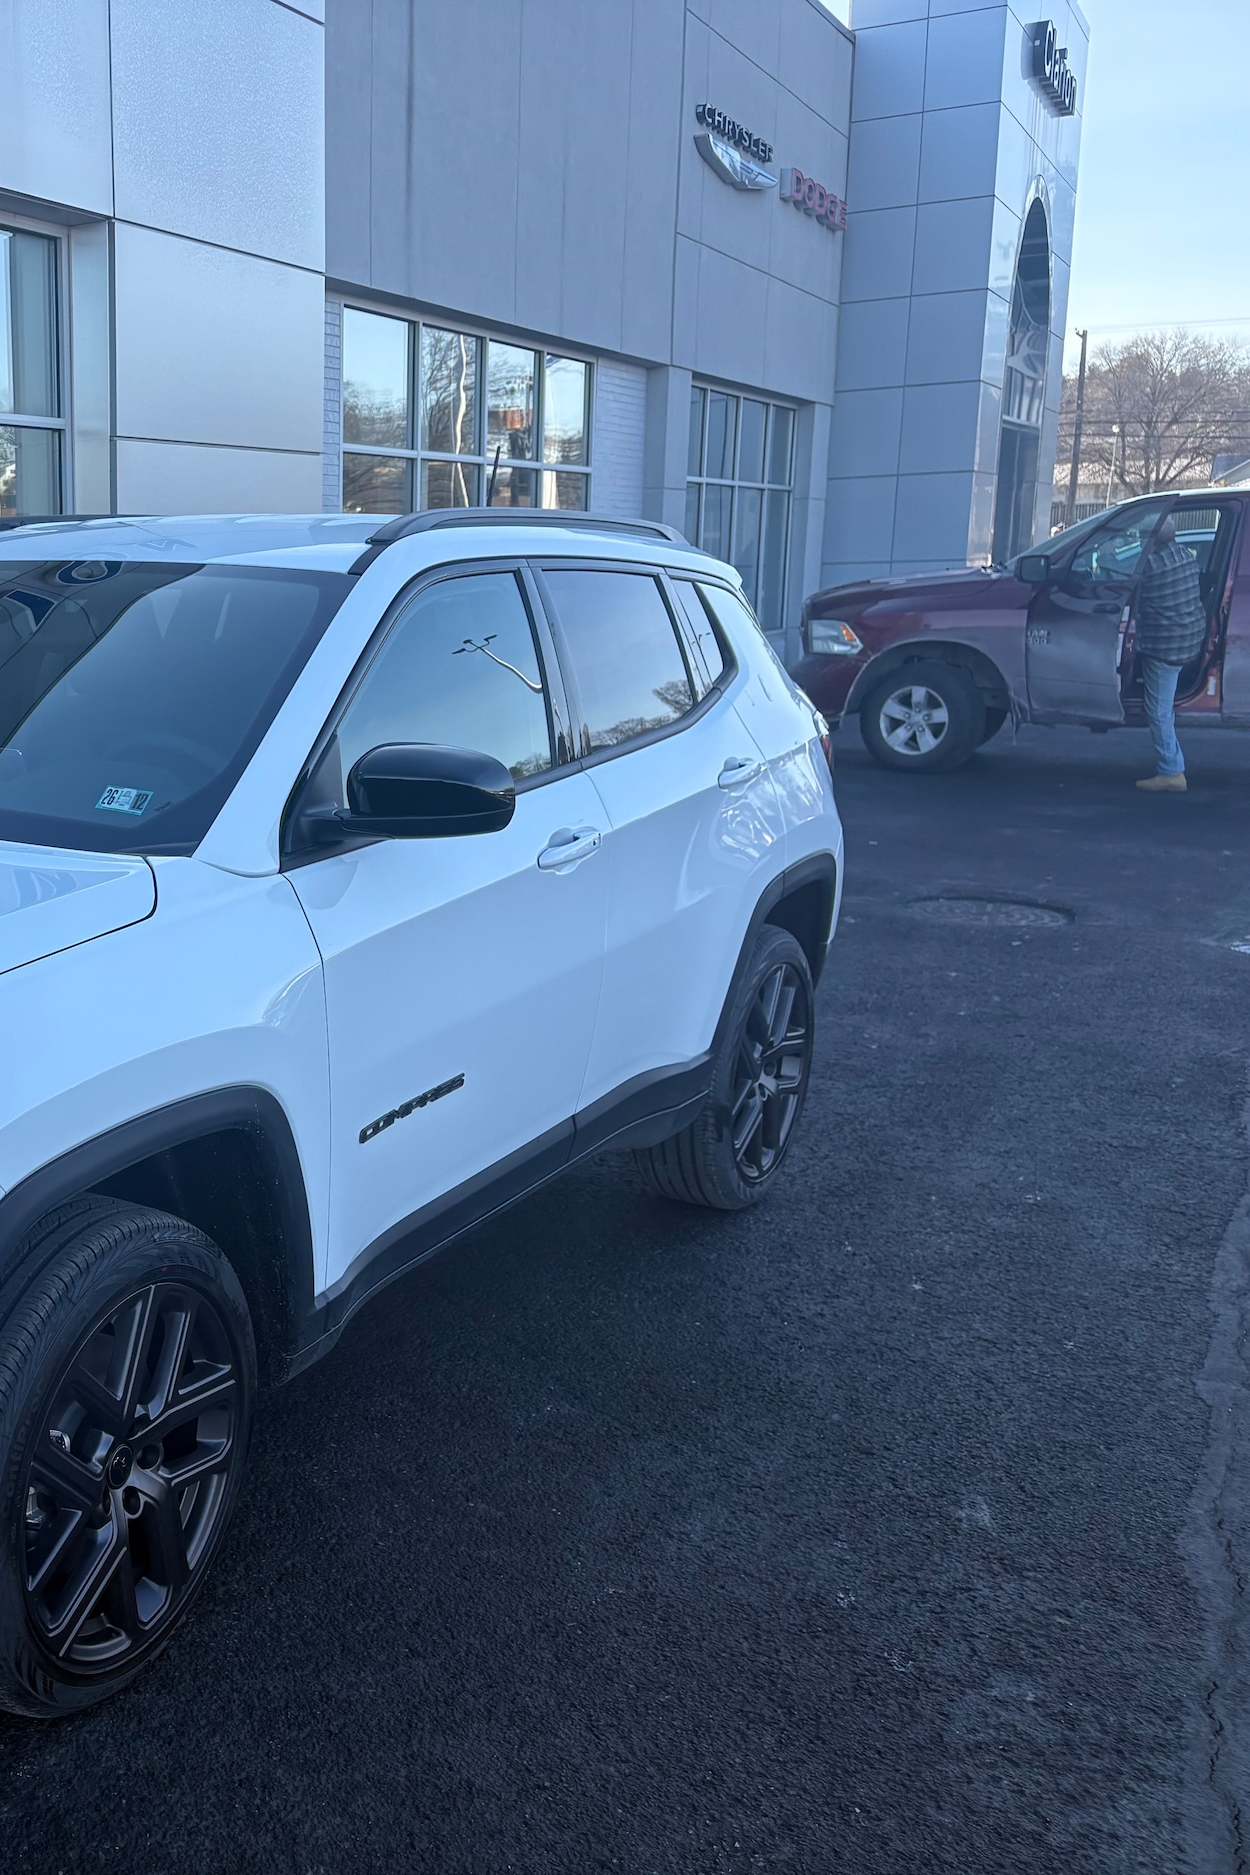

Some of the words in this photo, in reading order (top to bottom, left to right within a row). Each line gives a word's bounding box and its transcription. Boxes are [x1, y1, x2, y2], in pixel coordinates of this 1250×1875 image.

[699, 102, 774, 162] CHRYSLER
[787, 167, 848, 231] DODGE
[101, 788, 119, 805] 26
[132, 793, 150, 810] 12
[358, 1072, 466, 1144] COMPASS
